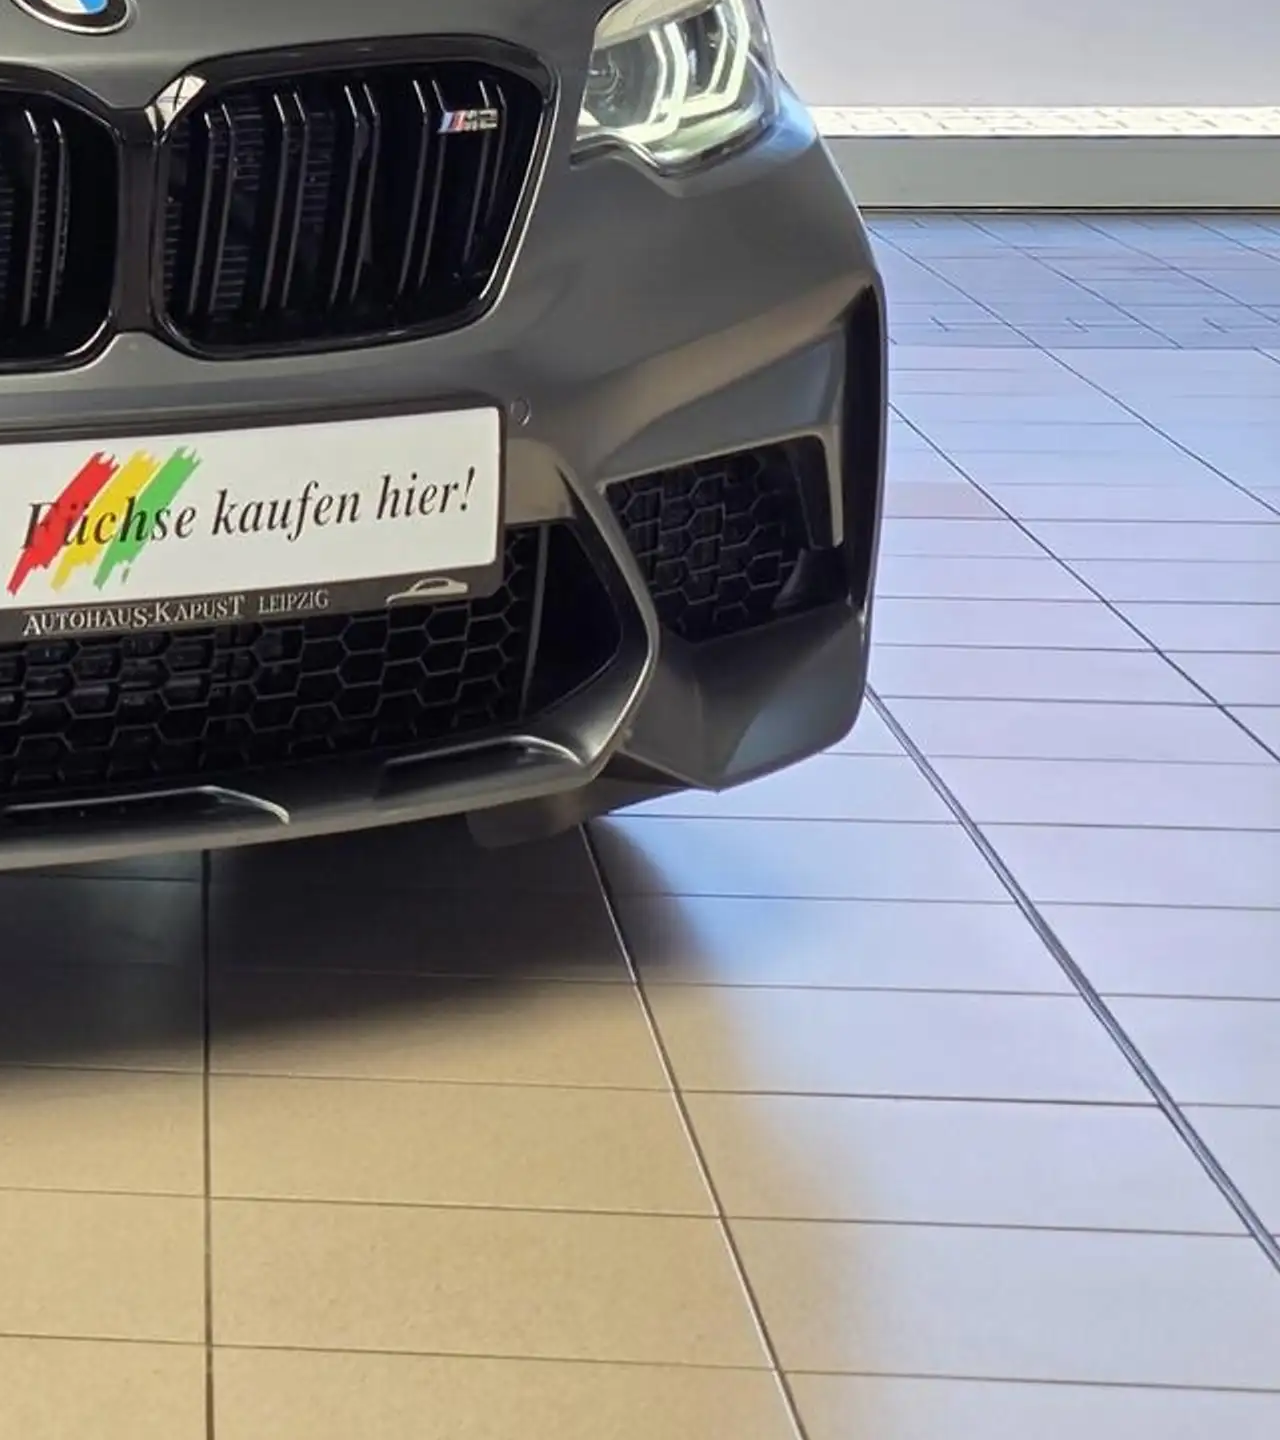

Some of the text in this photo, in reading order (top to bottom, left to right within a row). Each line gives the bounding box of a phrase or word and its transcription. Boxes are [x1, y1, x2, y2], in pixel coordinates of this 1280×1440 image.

[20, 466, 475, 550] Füchse kaufen hier!
[258, 589, 330, 615] LEIPZIG
